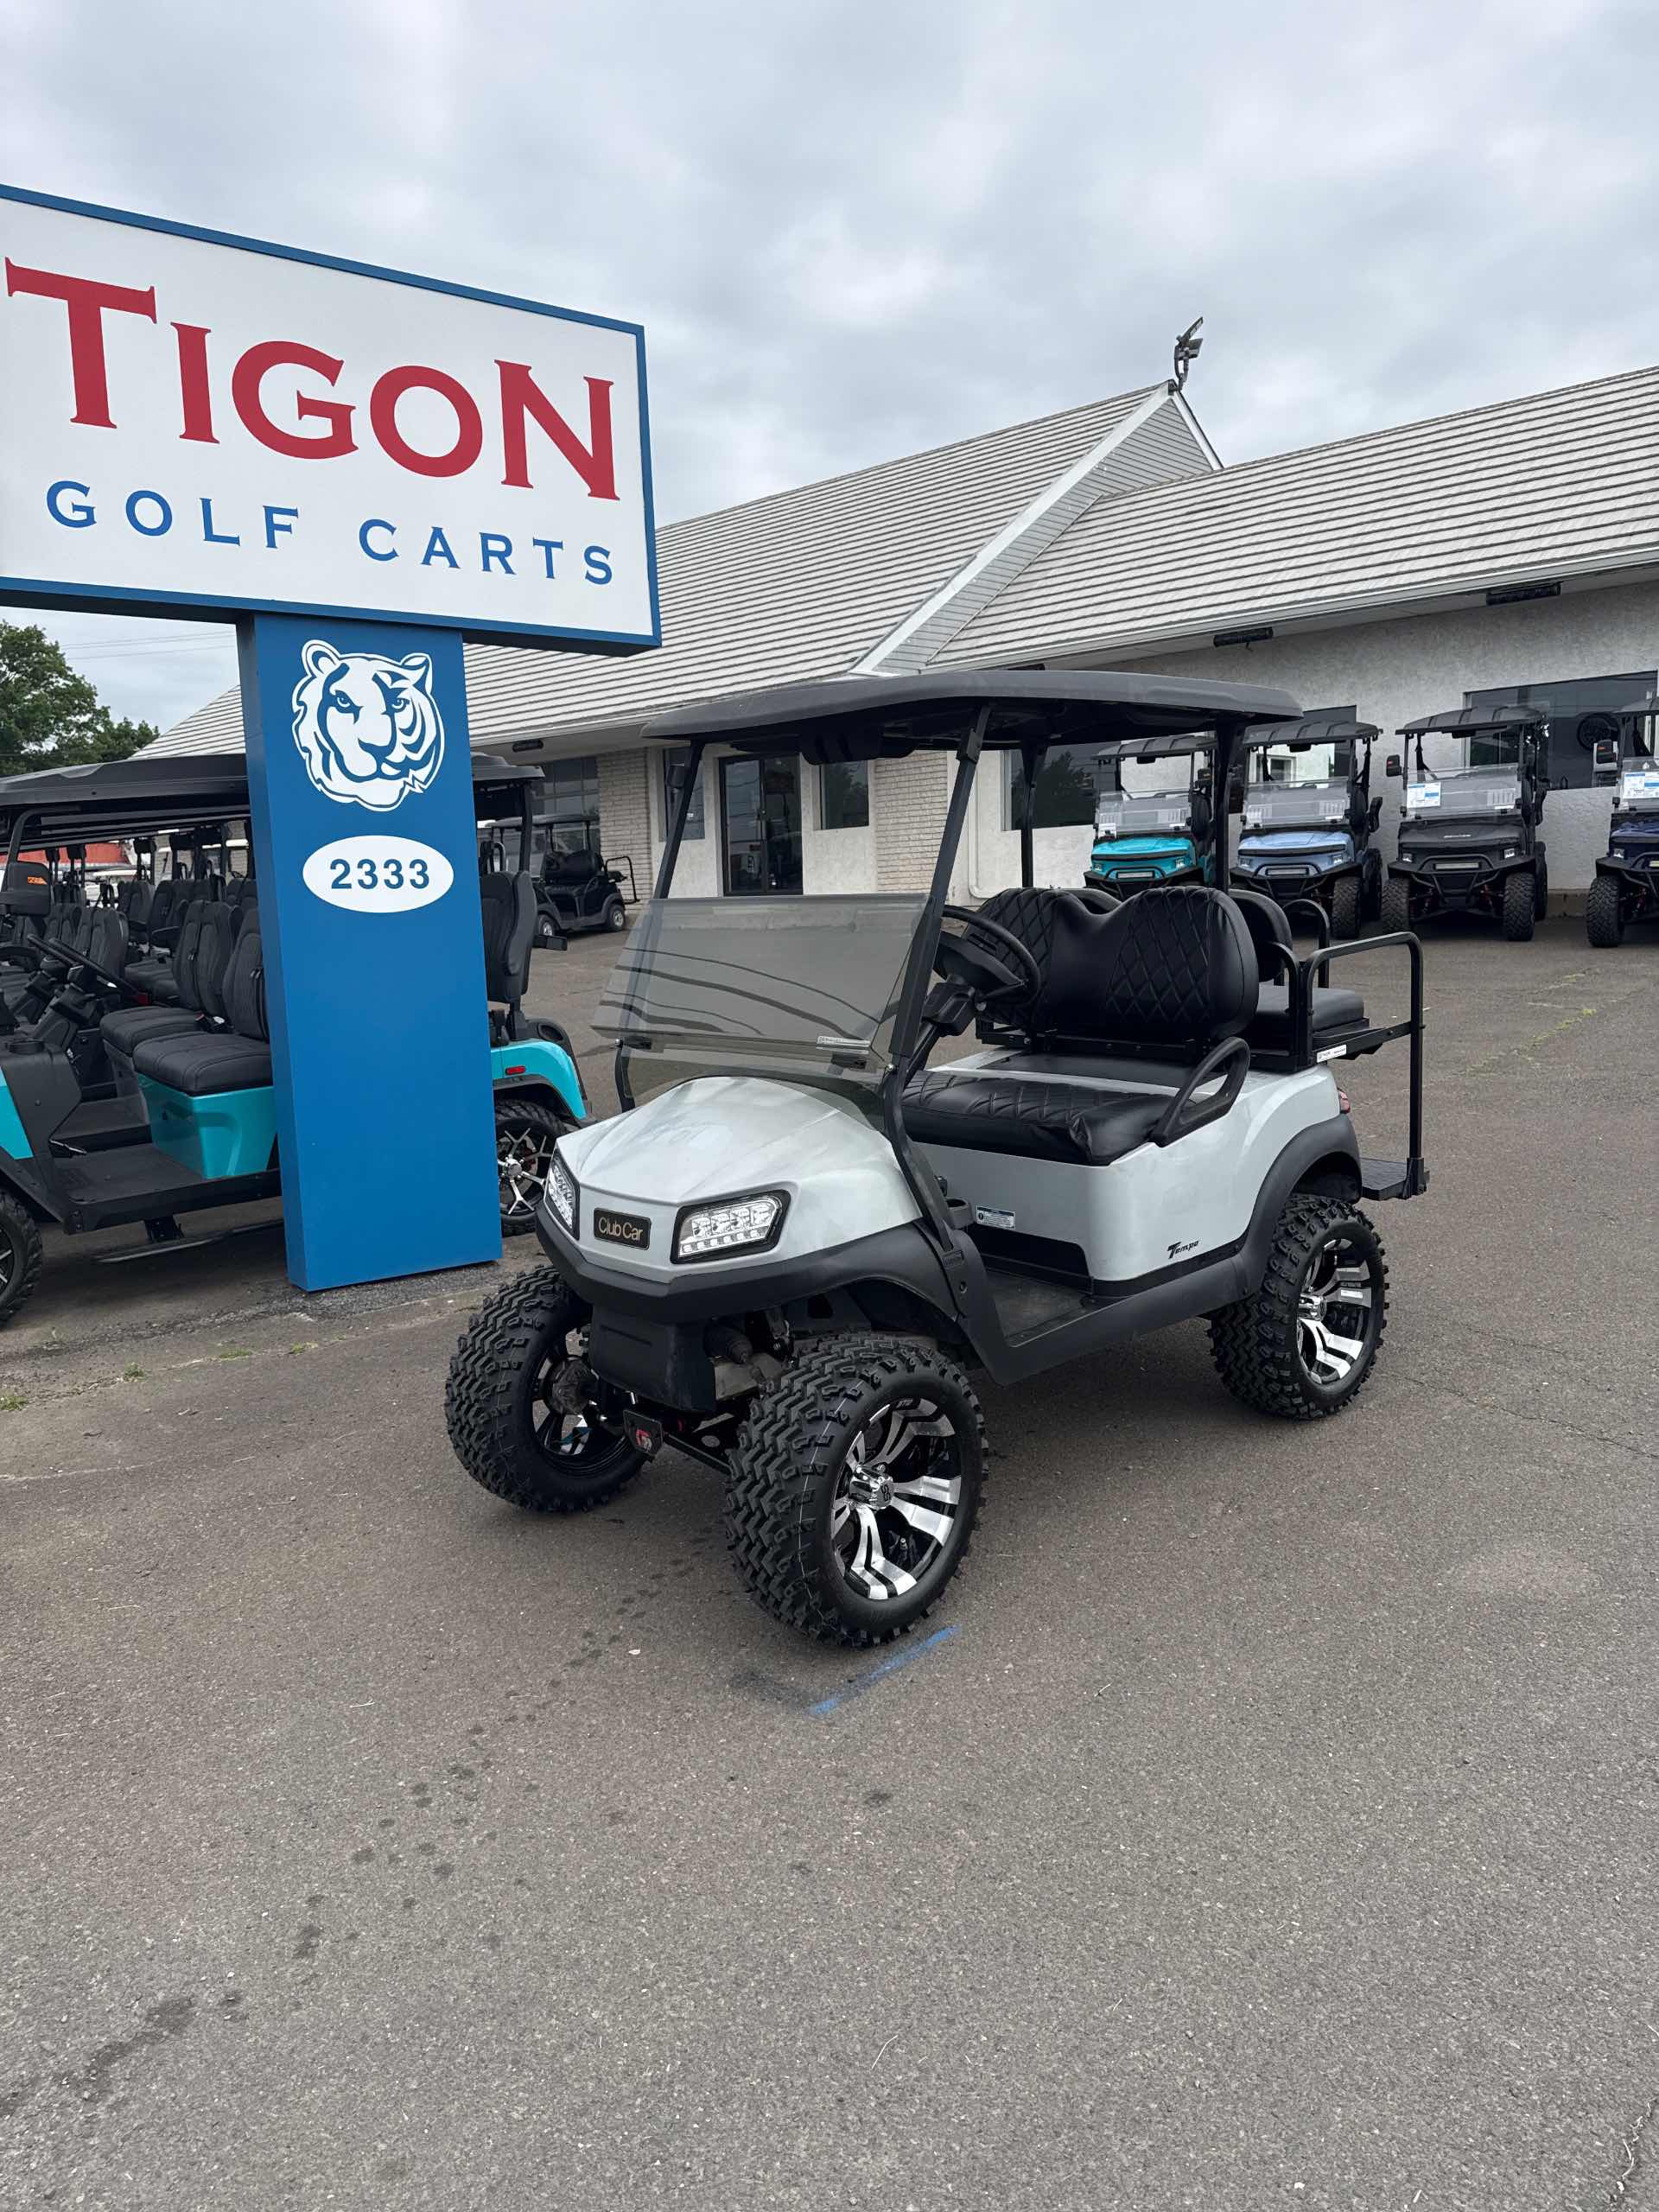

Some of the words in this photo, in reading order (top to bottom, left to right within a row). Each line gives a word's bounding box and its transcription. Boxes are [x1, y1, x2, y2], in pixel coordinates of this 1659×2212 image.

[5, 257, 620, 500] TIGON
[46, 480, 299, 549] GOLF
[359, 518, 613, 585] CARTS
[330, 858, 429, 889] 2333
[599, 1217, 621, 1236] Club
[622, 1222, 644, 1242] Car
[1167, 1240, 1199, 1260] Tempo
